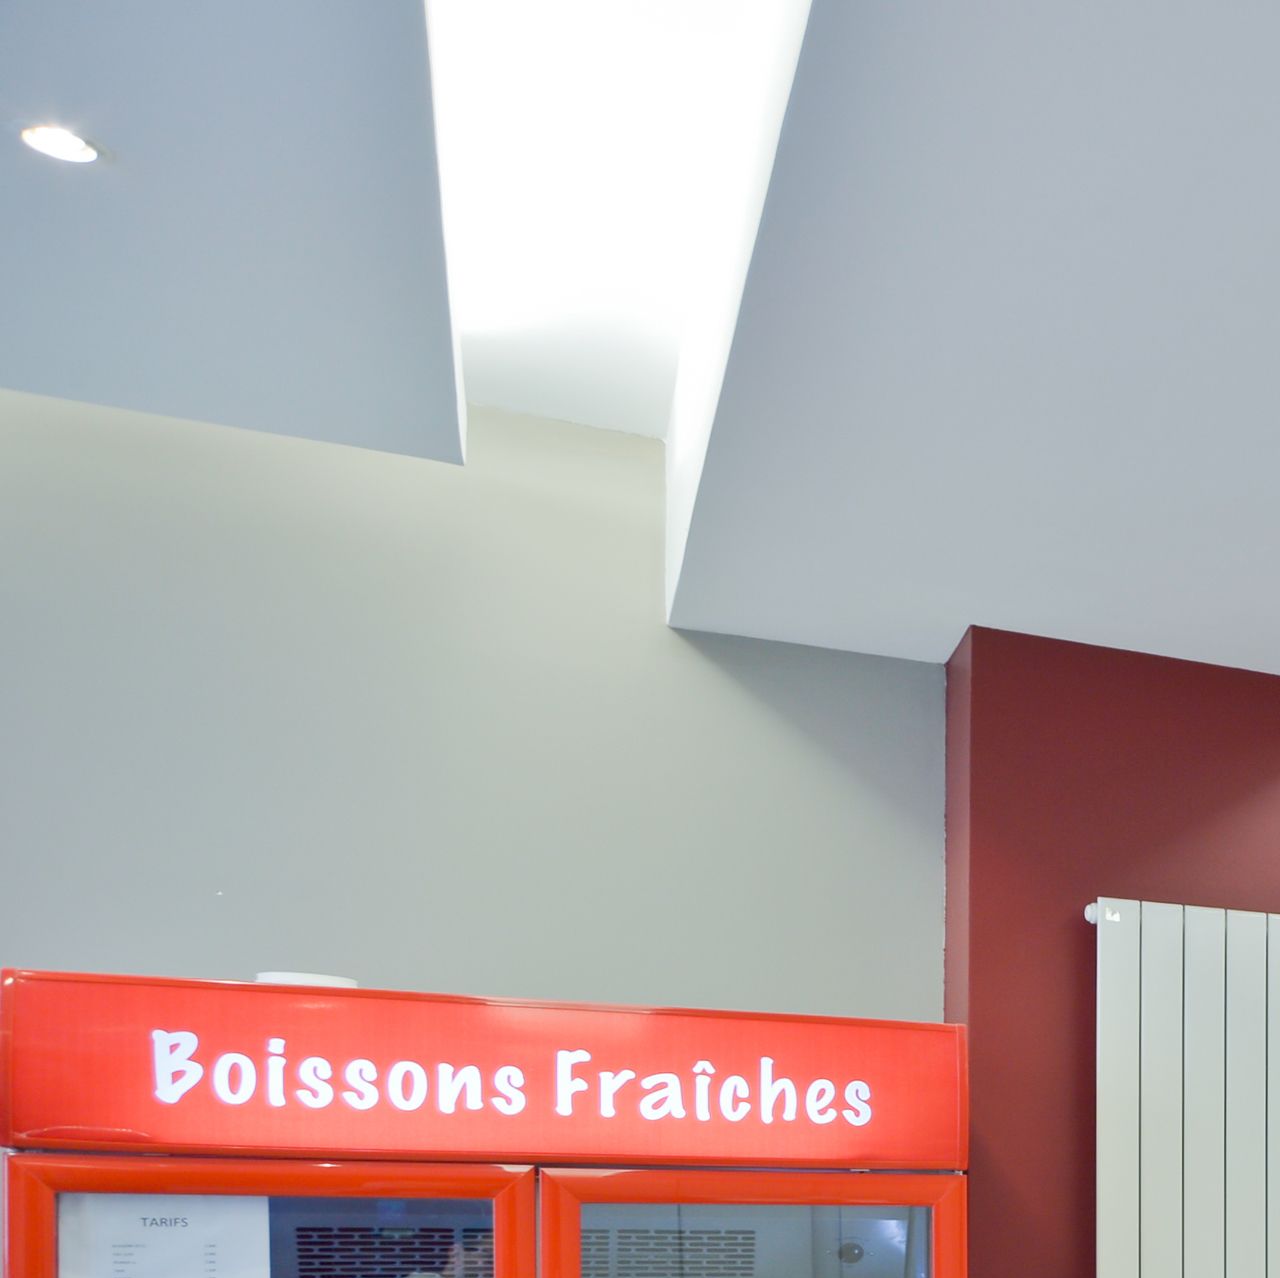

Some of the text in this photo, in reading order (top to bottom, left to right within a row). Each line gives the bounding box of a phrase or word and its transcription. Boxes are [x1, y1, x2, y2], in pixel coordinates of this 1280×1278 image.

[151, 1027, 873, 1127] Boissons Fraîches
[140, 1217, 189, 1228] TARIFS
